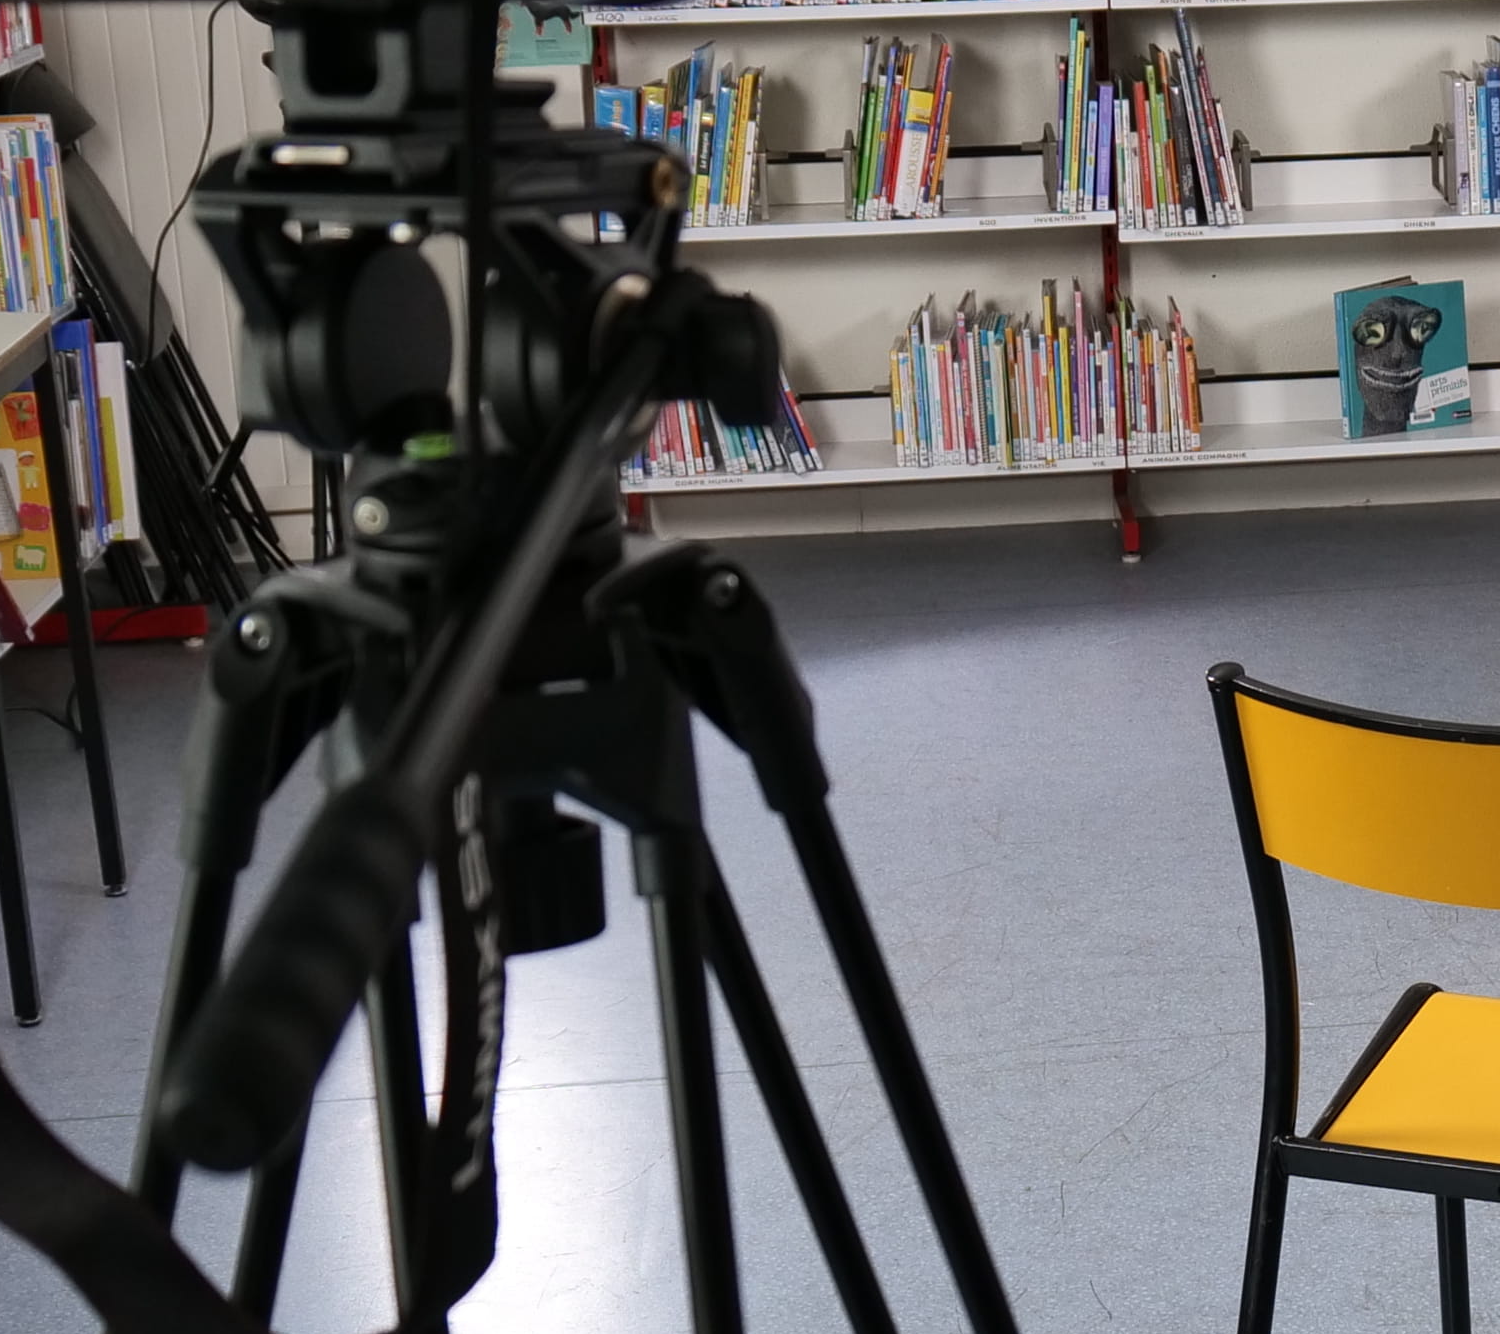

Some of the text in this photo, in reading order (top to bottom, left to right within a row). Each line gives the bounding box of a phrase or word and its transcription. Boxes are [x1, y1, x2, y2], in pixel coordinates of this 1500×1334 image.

[595, 12, 625, 23] 400
[1490, 96, 1500, 136] CHIENS
[1033, 215, 1087, 224] INVENTIONS
[1403, 220, 1436, 228] CHIENS
[1164, 230, 1204, 238] CHEVAUX
[1429, 374, 1469, 398] arts primitifs
[1141, 452, 1247, 463] ANIMAUX DE COMPAGNIE
[996, 462, 1058, 471] ALIMENTATION
[675, 477, 744, 487] CORPS HUMAIN
